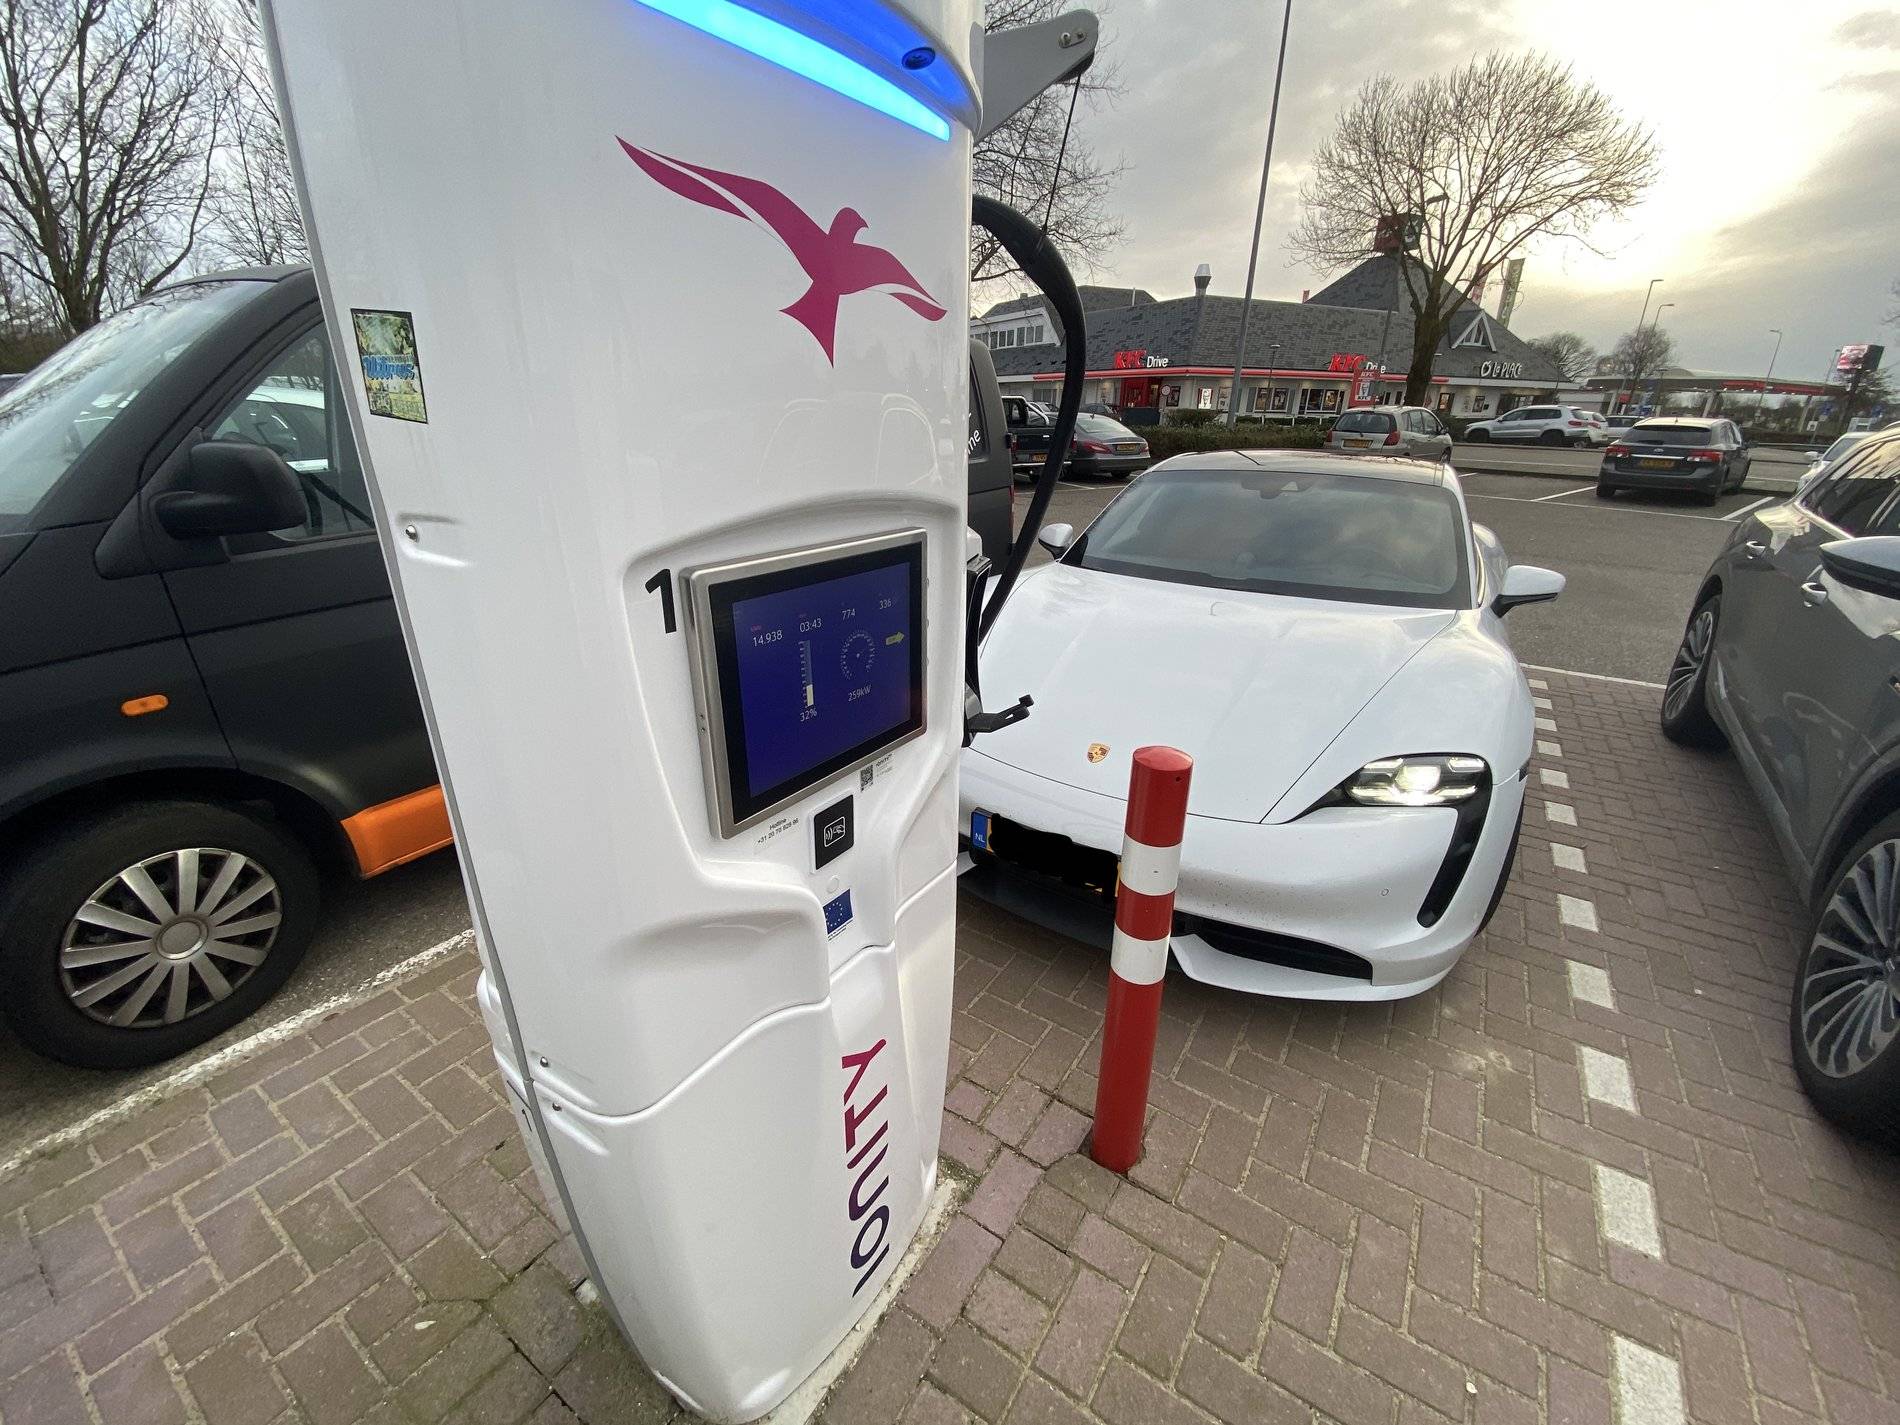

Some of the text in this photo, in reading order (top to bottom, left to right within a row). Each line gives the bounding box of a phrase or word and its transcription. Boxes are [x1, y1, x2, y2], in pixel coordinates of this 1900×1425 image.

[1115, 349, 1169, 368] KFC Drive
[1328, 353, 1386, 374] KFC Drie
[644, 568, 677, 634] 1
[841, 608, 856, 621] 774
[799, 617, 823, 633] 03:43
[753, 629, 783, 647] 14.938
[799, 707, 818, 722] 32%
[974, 832, 986, 843] NL
[841, 1039, 890, 1298] IONITY
